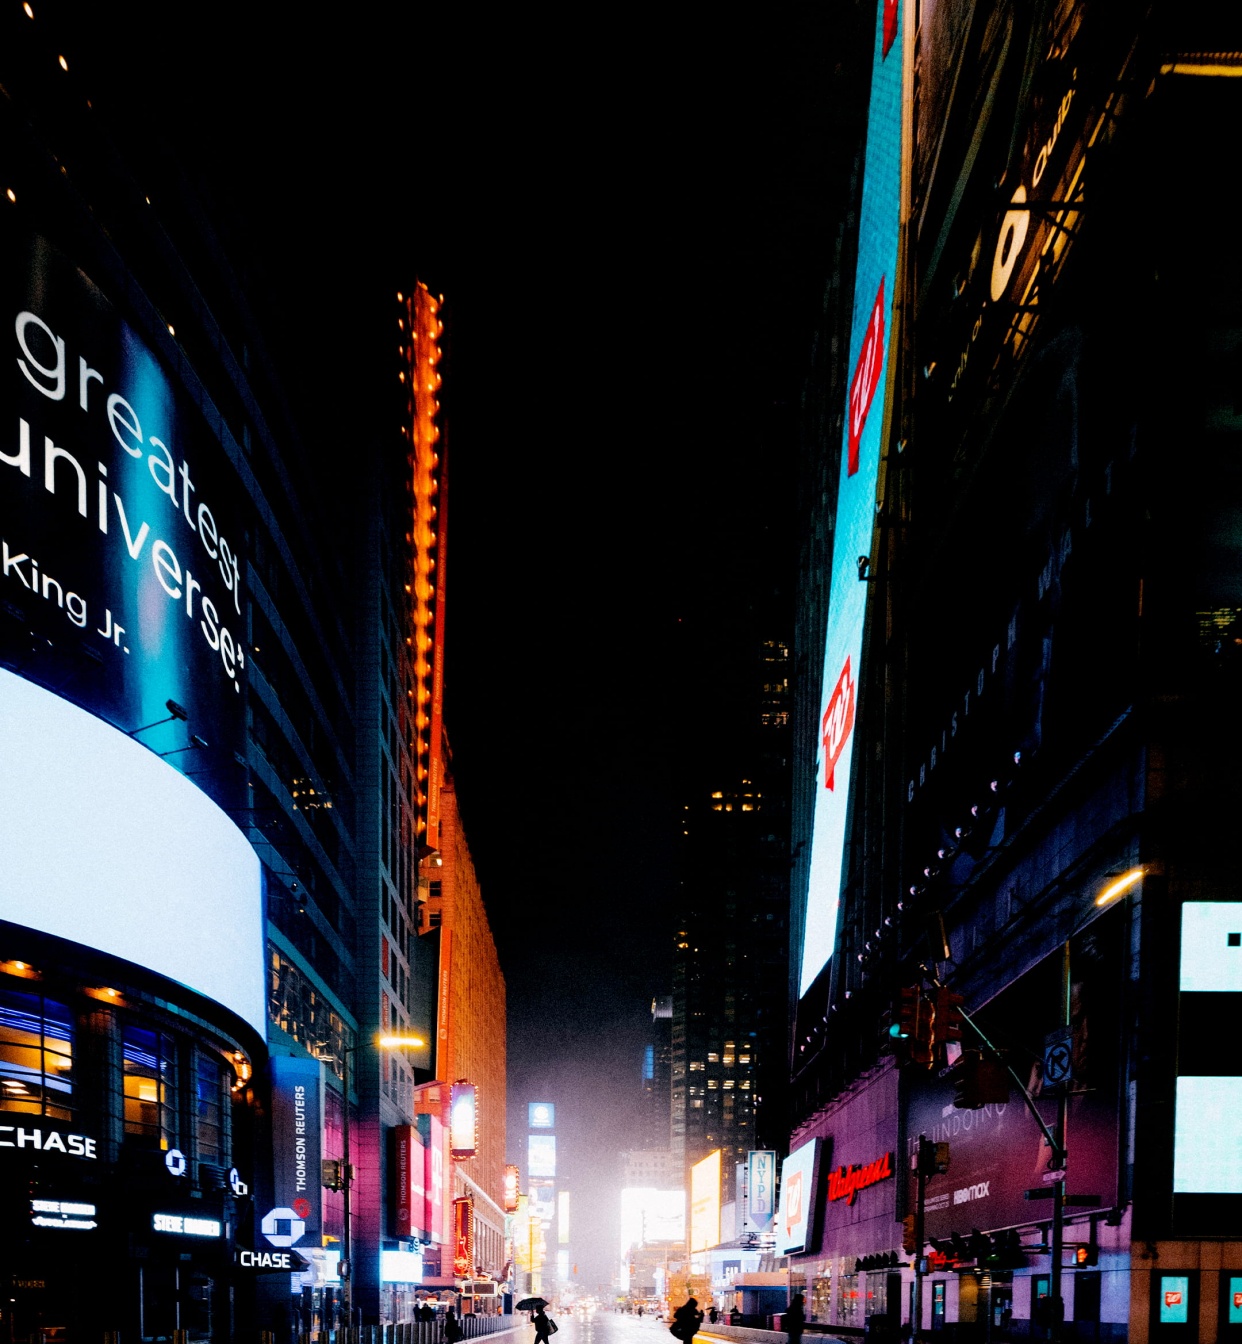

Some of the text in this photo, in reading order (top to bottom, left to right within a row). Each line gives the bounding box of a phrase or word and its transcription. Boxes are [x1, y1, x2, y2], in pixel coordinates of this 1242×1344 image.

[15, 310, 241, 615] greatest
[3, 541, 131, 654] King Jr.
[0, 1126, 97, 1159] CHASE
[295, 1085, 306, 1192] THOMSON REUTERS
[907, 1131, 926, 1156] TH
[757, 1155, 766, 1213] NYPD
[828, 1151, 892, 1206] Walgreens
[240, 1251, 291, 1269] CHASE
